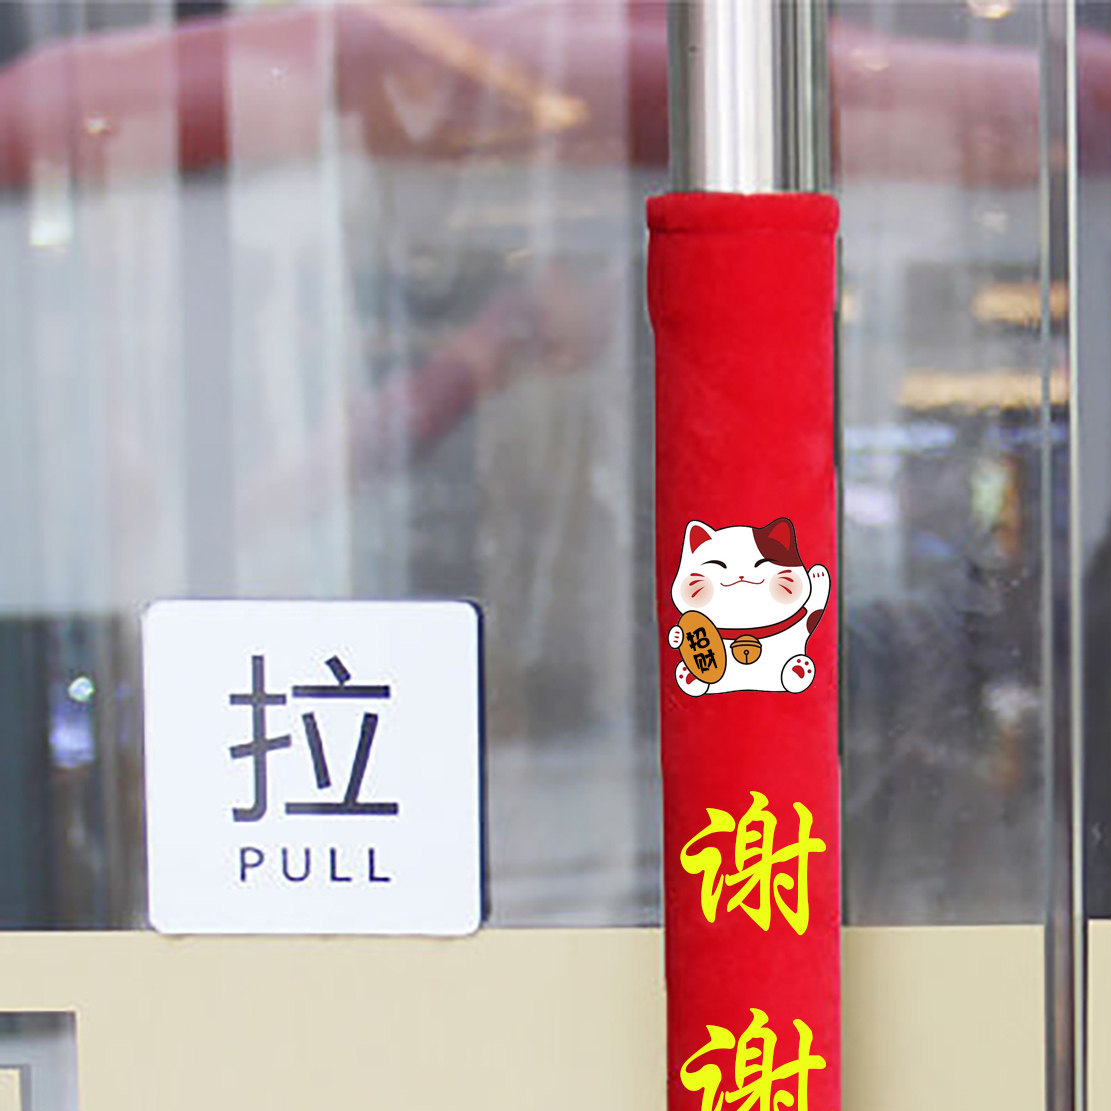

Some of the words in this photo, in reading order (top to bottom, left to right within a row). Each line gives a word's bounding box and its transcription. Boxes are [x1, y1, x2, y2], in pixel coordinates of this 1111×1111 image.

[686, 626, 718, 674] 招财
[229, 655, 399, 823] 拉
[239, 846, 392, 884] PULL
